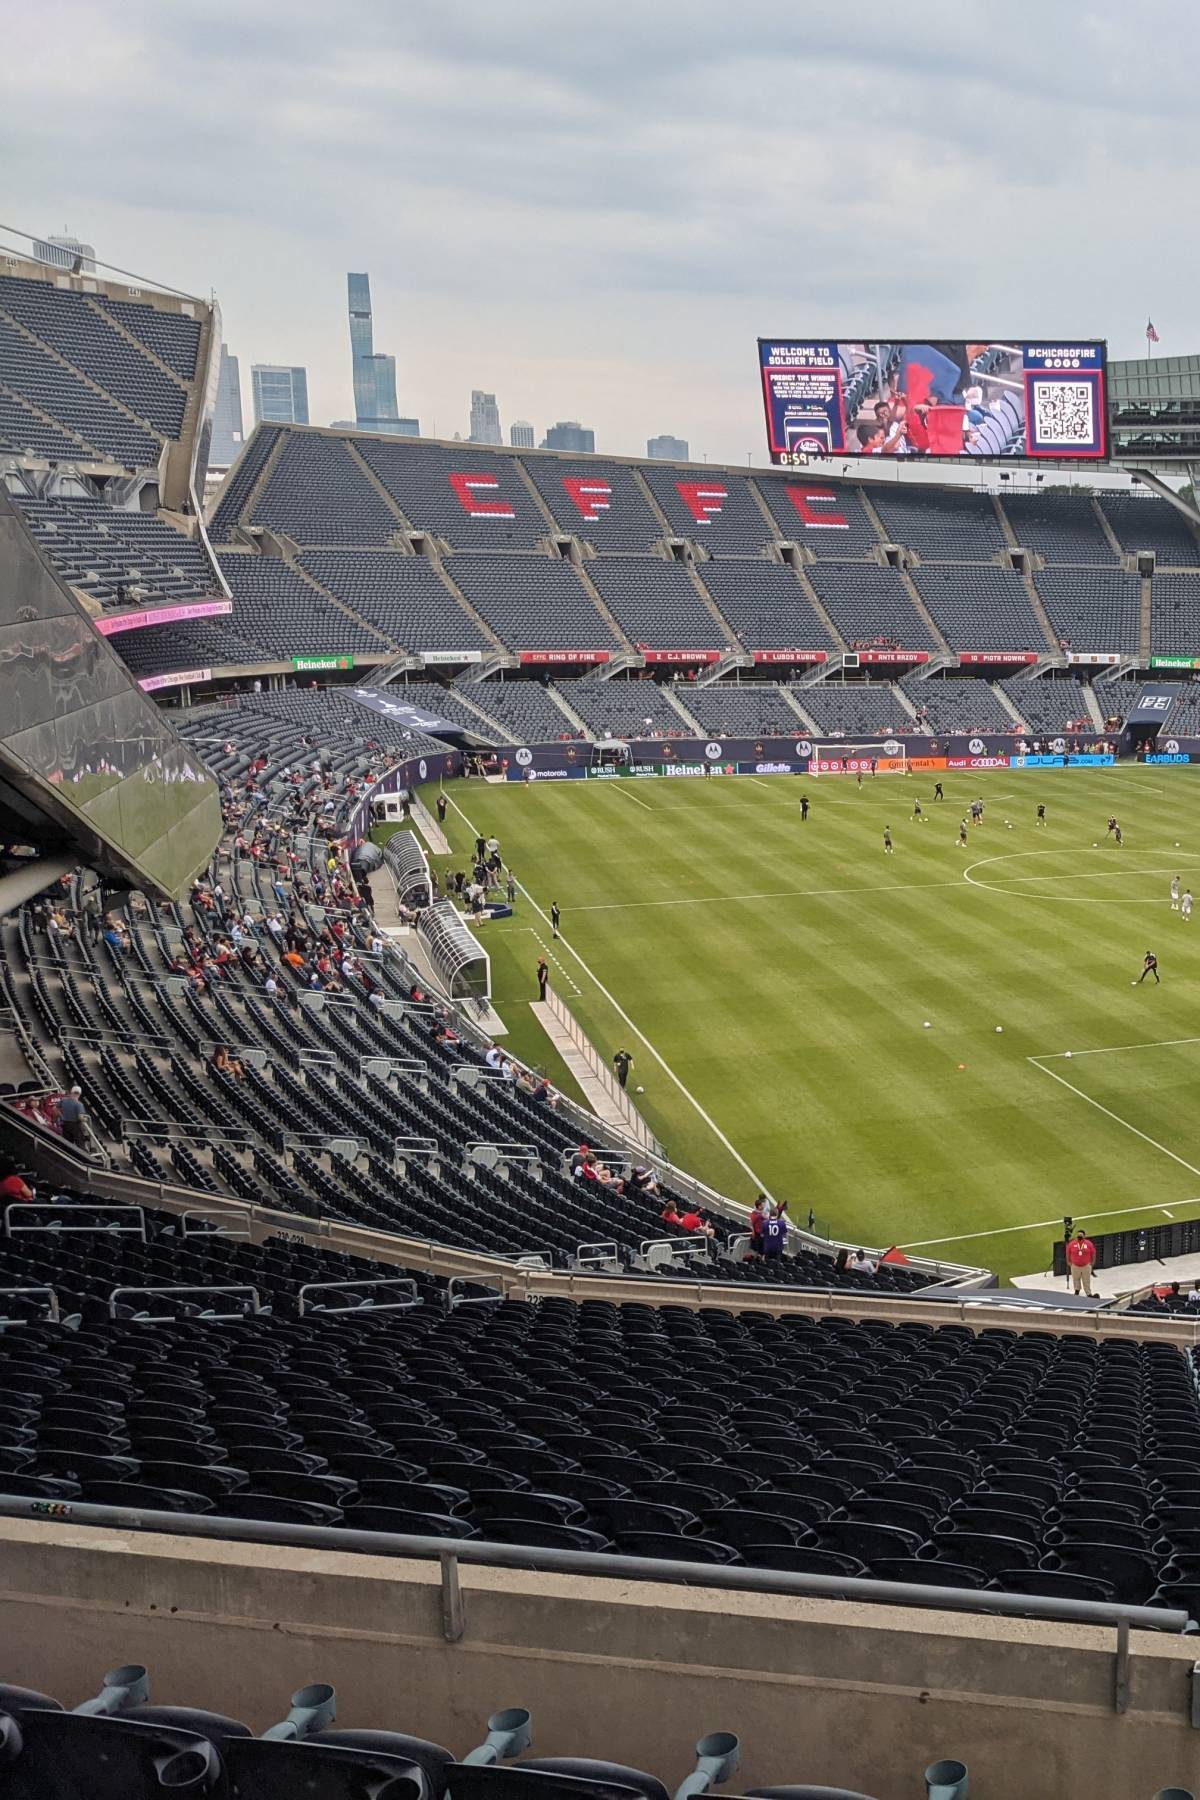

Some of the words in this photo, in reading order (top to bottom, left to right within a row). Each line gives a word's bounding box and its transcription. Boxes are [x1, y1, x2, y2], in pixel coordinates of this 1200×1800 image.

[770, 347, 816, 356] WELCOME
[818, 348, 830, 356] TO
[768, 356, 806, 365] SOLDIER
[808, 357, 834, 366] FIELD
[780, 452, 807, 464] 0:59
[296, 659, 338, 670] Heineken
[1155, 658, 1191, 668] Heineken
[1146, 754, 1190, 764] EARBUDS
[536, 769, 568, 778] motorola
[756, 763, 790, 774] Gillette
[768, 1224, 779, 1236] 10
